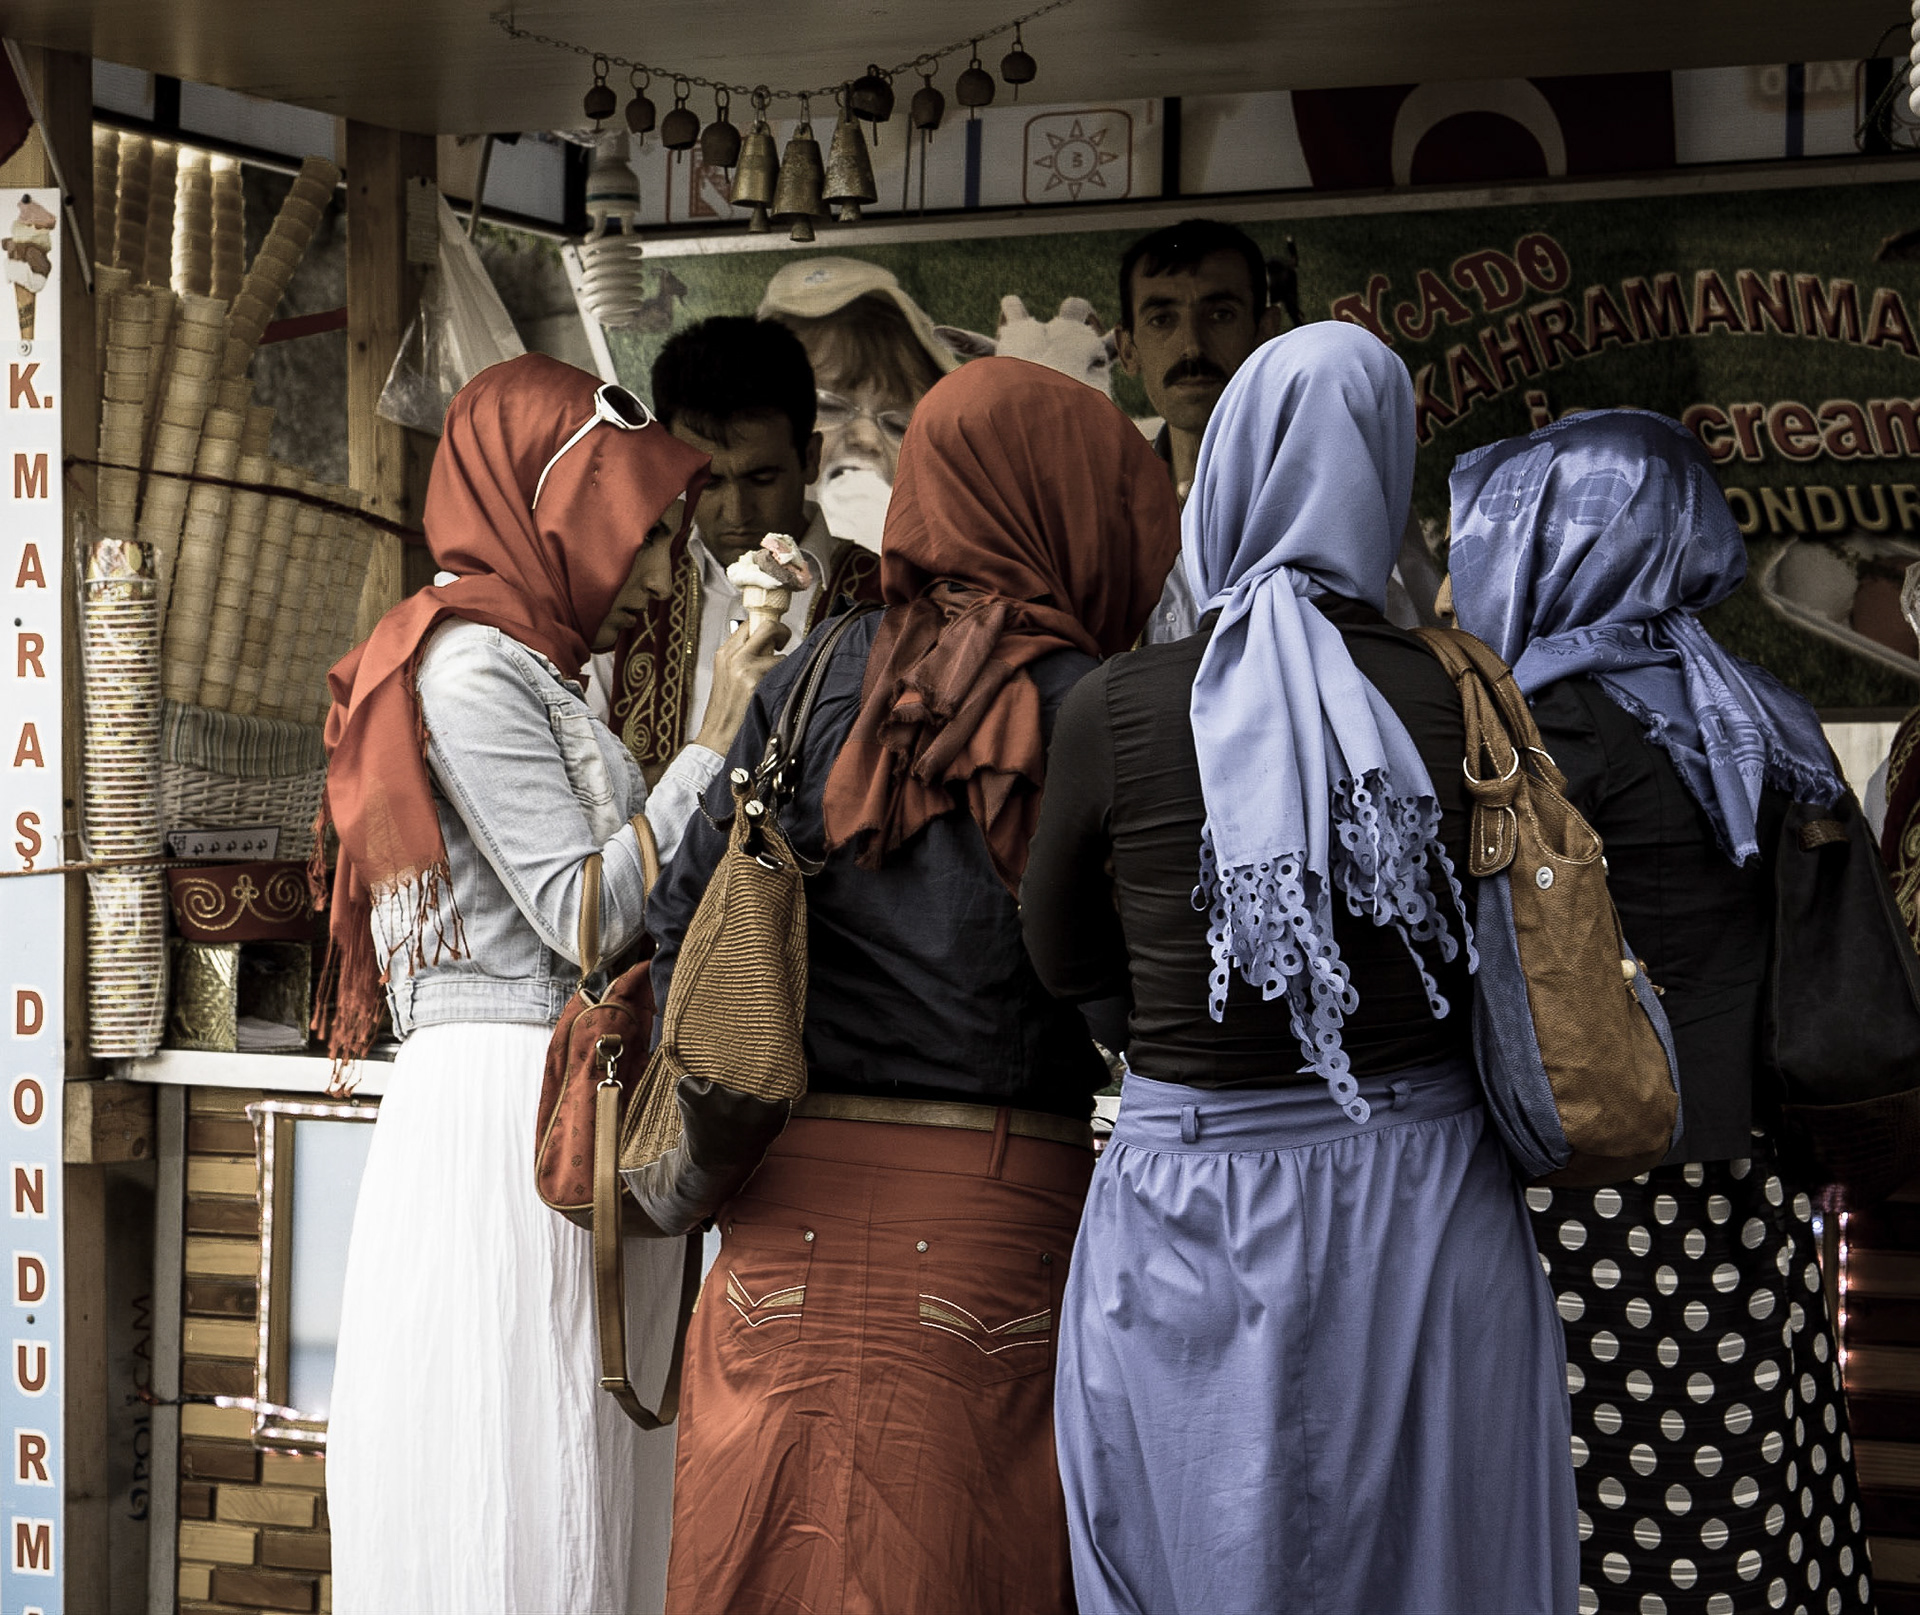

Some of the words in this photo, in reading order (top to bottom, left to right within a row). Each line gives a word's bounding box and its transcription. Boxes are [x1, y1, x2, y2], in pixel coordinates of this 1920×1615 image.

[1332, 233, 1571, 346] YADO
[1725, 484, 1920, 537] ONDUR
[15, 989, 50, 1615] DONDURM
